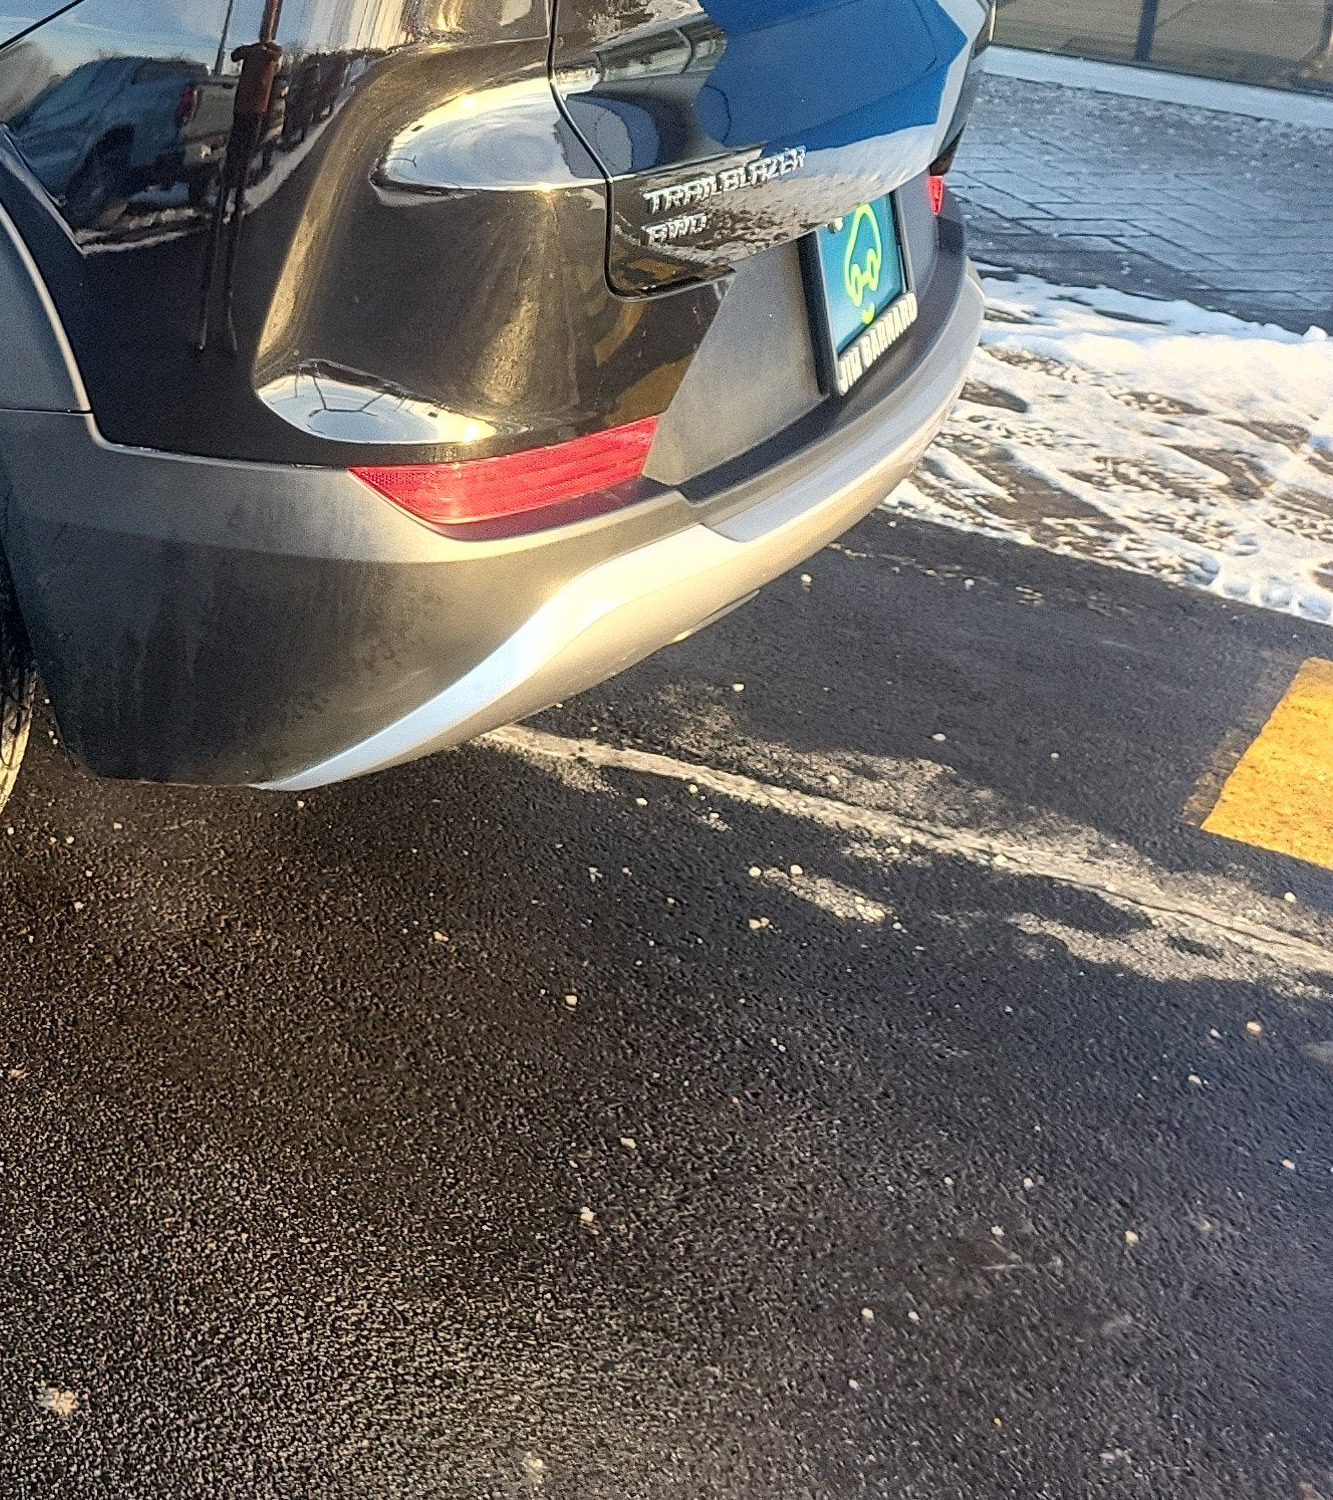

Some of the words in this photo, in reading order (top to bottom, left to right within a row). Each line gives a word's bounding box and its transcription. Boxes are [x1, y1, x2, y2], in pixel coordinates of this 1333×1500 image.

[643, 145, 807, 215] TRAILBLAZER
[641, 213, 708, 246] AWD
[839, 346, 863, 396] JIM
[861, 292, 918, 368] BARNARD
